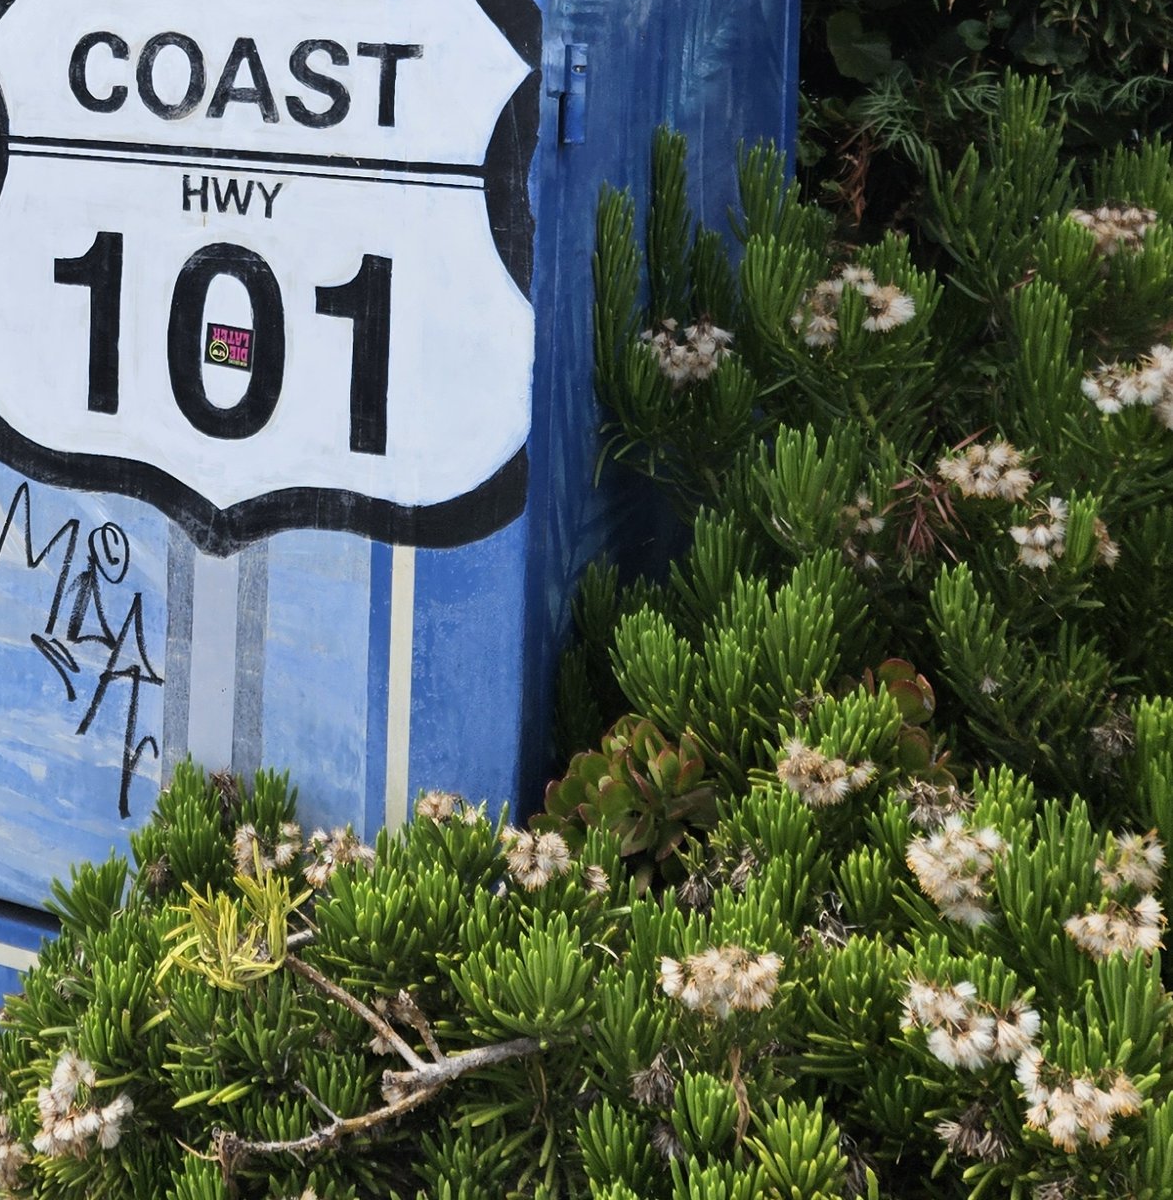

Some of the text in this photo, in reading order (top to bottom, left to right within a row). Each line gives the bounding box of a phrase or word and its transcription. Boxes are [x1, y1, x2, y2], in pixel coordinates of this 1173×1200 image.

[68, 31, 425, 130] COAST
[182, 174, 284, 219] HWY
[54, 230, 393, 456] 101
[212, 328, 250, 348] LATER
[229, 345, 248, 362] DIE
